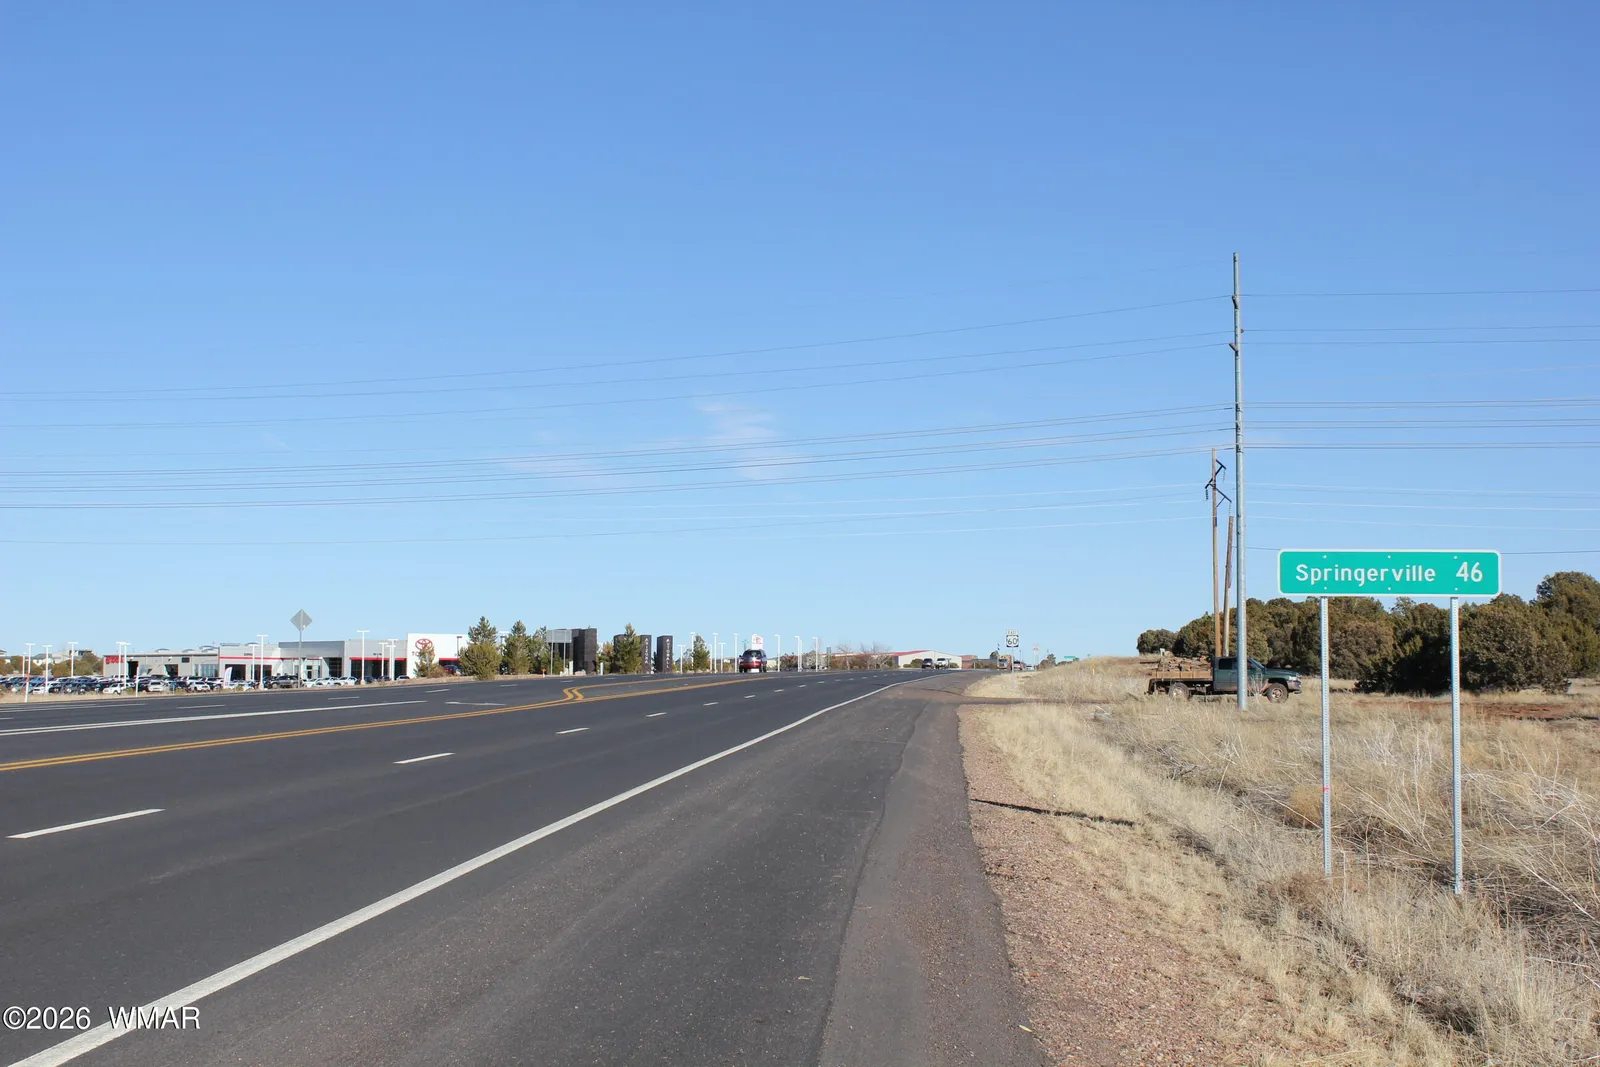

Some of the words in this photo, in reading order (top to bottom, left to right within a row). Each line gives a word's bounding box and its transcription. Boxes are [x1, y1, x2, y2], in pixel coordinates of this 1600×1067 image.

[1295, 564, 1436, 587] Springerville
[1455, 562, 1484, 582] 46
[1007, 637, 1018, 645] 60
